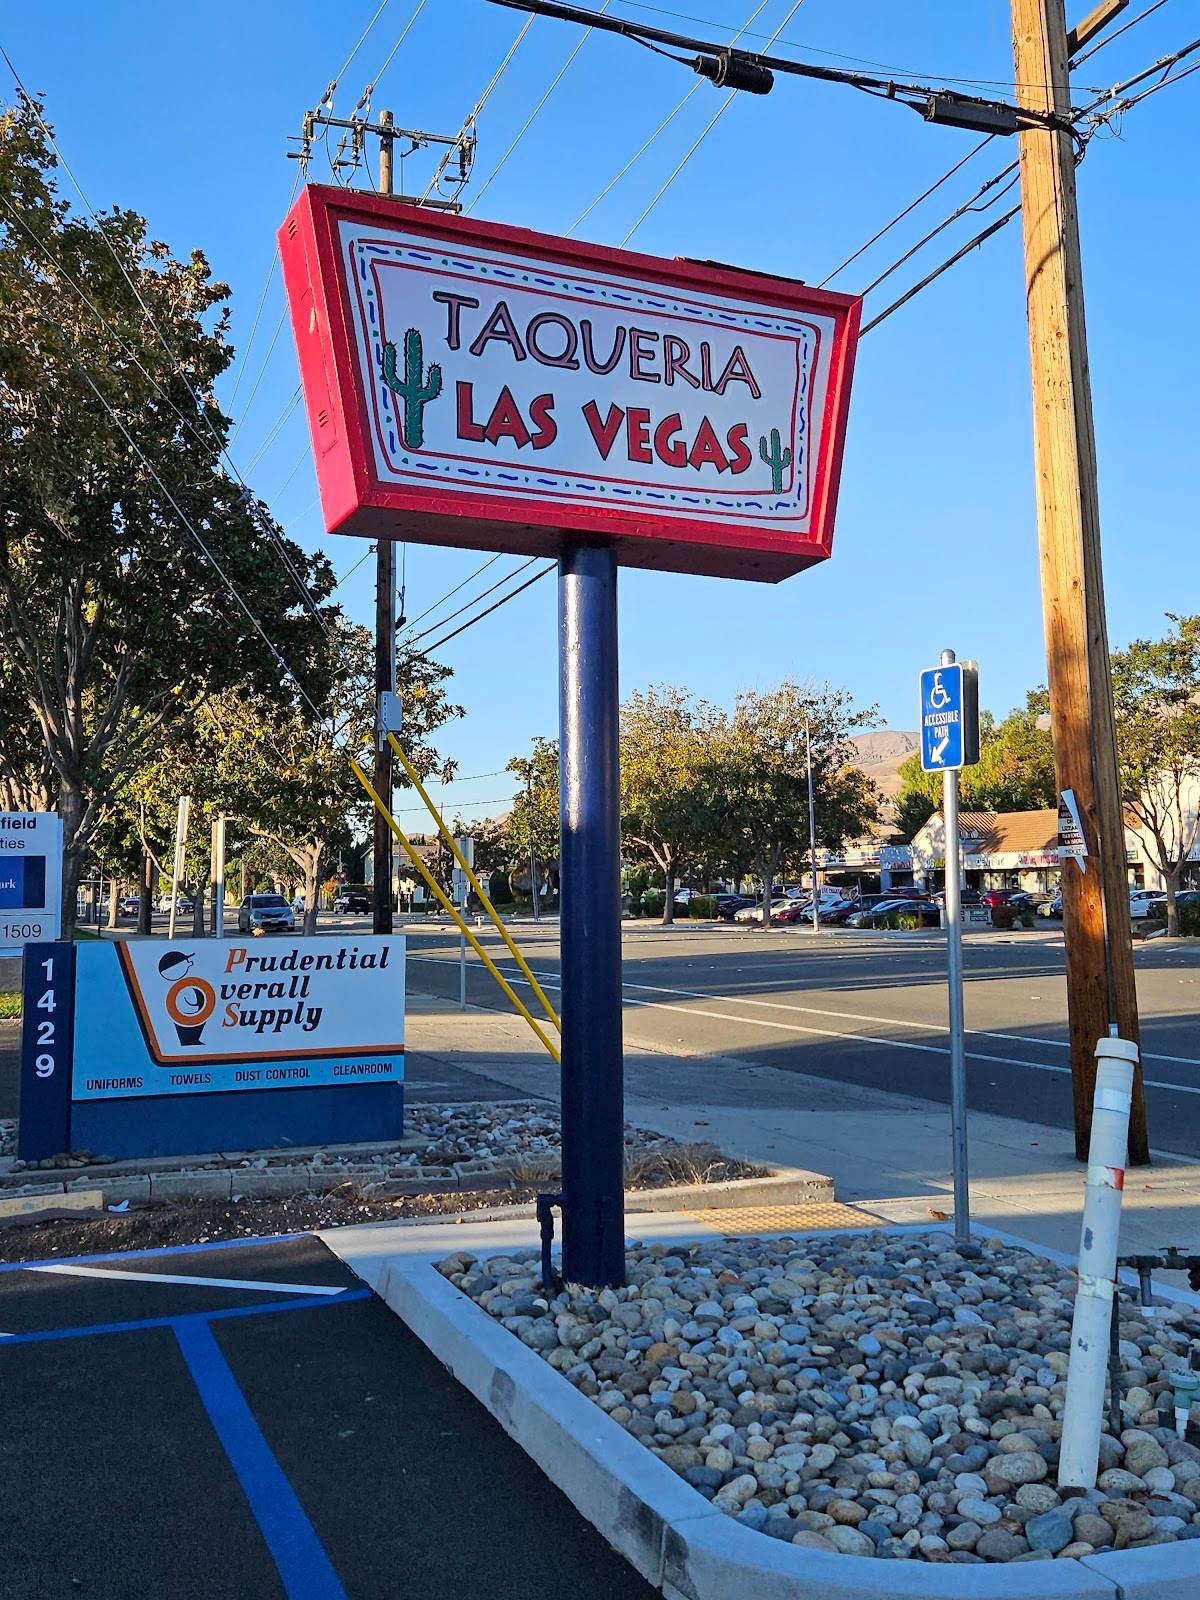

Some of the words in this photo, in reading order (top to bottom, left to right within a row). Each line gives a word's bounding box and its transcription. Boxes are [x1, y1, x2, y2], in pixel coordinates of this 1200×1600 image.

[433, 290, 762, 399] TAQUERIA
[455, 380, 557, 451] LAS
[582, 400, 753, 475] VEGAS
[924, 710, 959, 727] ACCESSIBLE
[934, 725, 949, 738] PATH
[2, 924, 42, 939] 1509
[224, 946, 390, 973] Prudential
[222, 1001, 324, 1034] Supply
[86, 1076, 144, 1090] UNIFORMS
[169, 1072, 212, 1086] TOWELS
[235, 1069, 262, 1082] DUST
[265, 1067, 311, 1080] CONTROL
[333, 1063, 393, 1077] CLEANROOM
